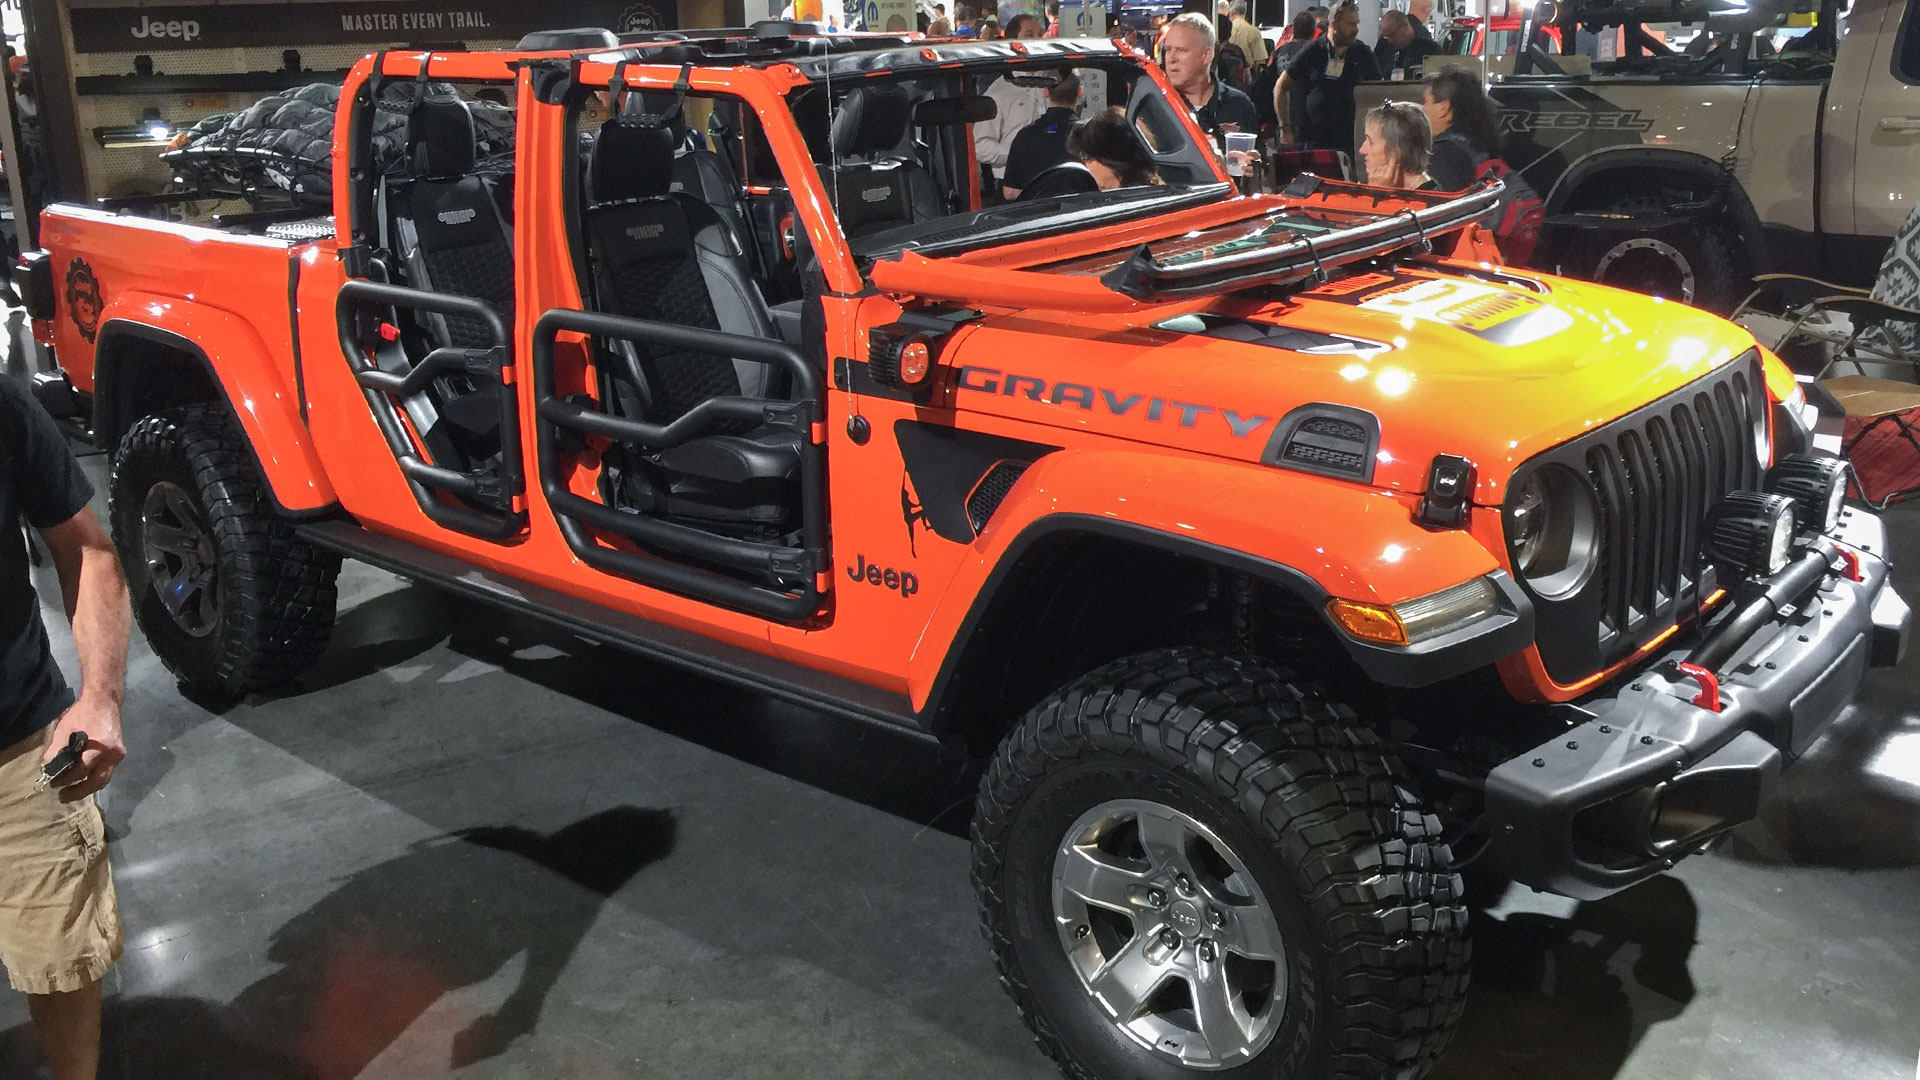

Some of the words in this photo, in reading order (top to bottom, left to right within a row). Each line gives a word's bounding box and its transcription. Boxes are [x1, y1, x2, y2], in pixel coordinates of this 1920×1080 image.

[130, 15, 200, 42] Jeep
[341, 14, 398, 31] MASTER
[402, 12, 443, 30] EVERY
[448, 11, 491, 28] TRAIL.
[629, 16, 652, 26] Jeep
[1498, 108, 1656, 133] REBEL
[957, 365, 1271, 437] GRAVITY
[846, 553, 919, 599] Jeep
